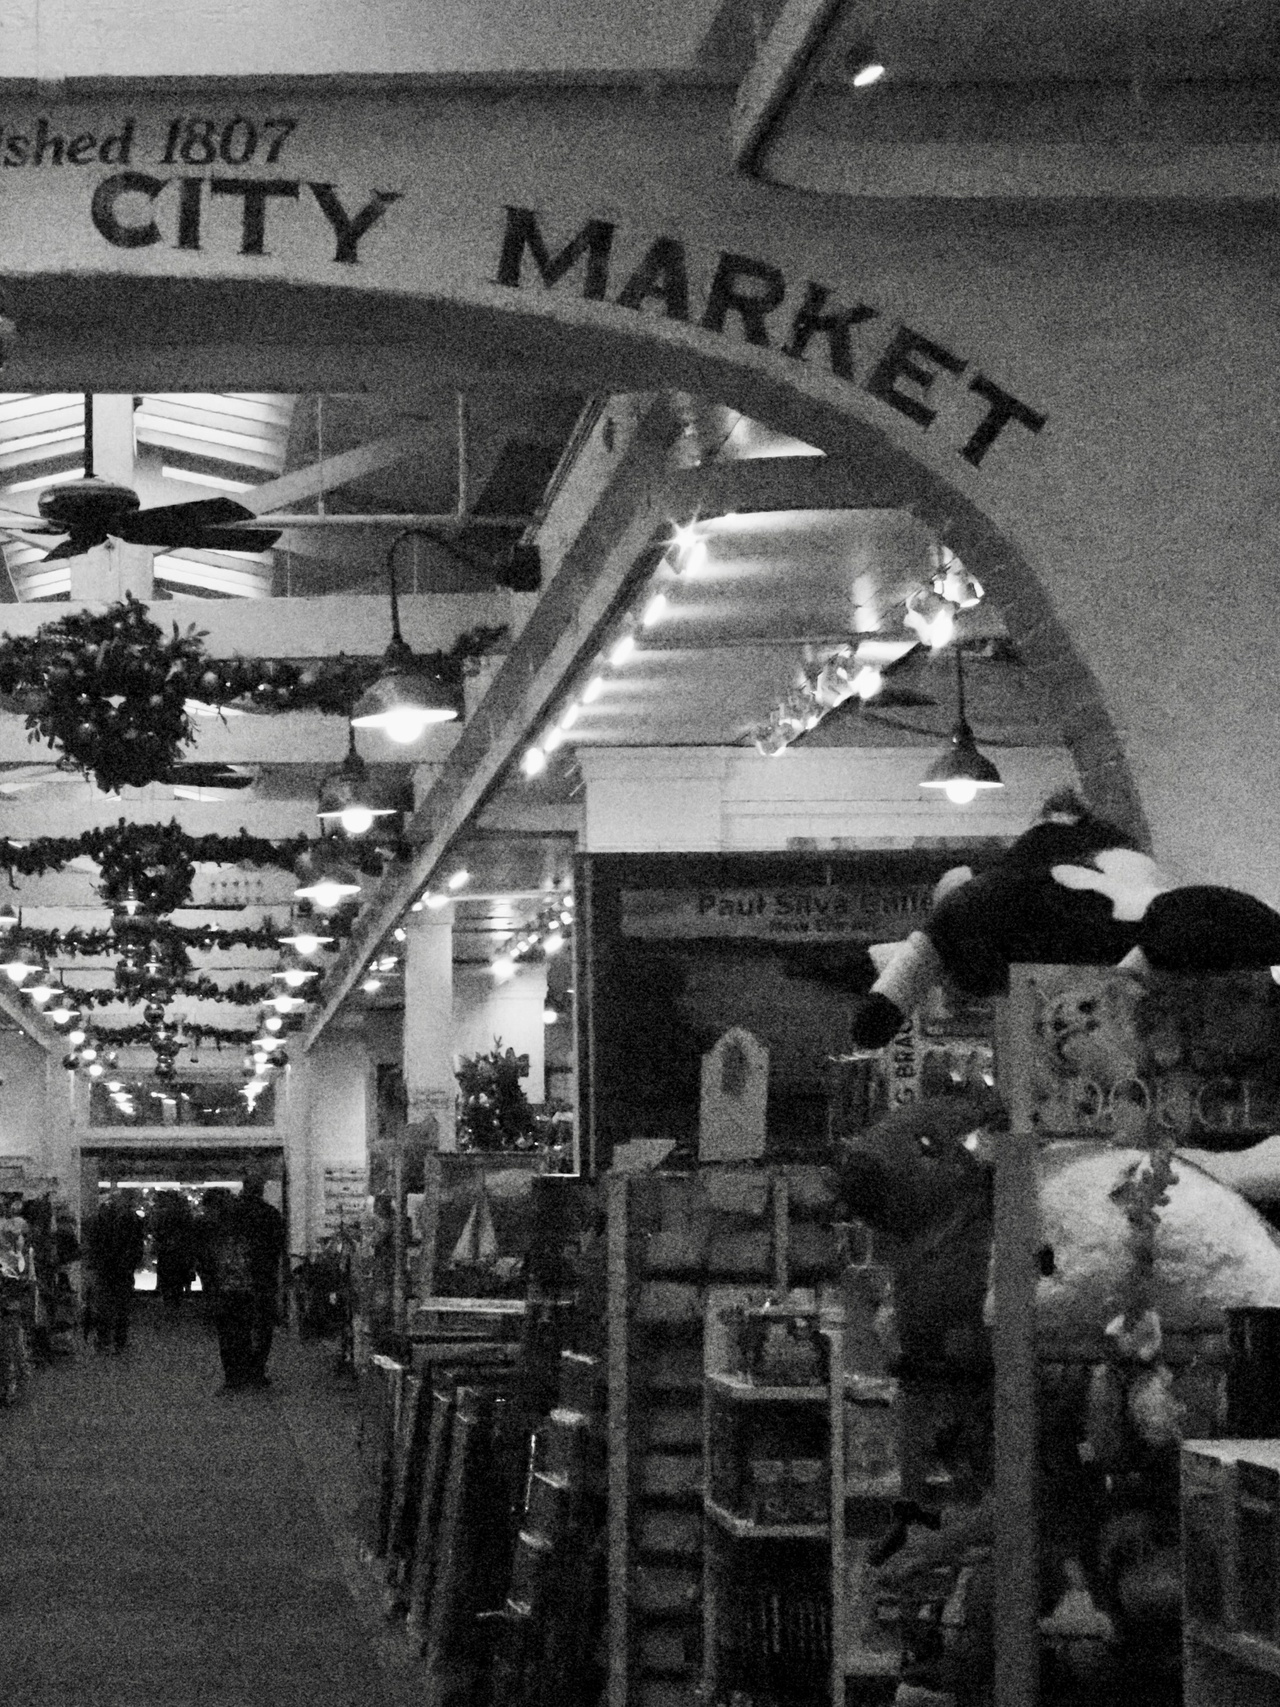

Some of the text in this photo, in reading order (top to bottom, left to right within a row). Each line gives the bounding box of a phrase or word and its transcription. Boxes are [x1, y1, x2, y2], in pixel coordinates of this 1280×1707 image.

[160, 117, 300, 166] 1807
[90, 171, 405, 266] CITY
[489, 203, 1048, 468] MARKET
